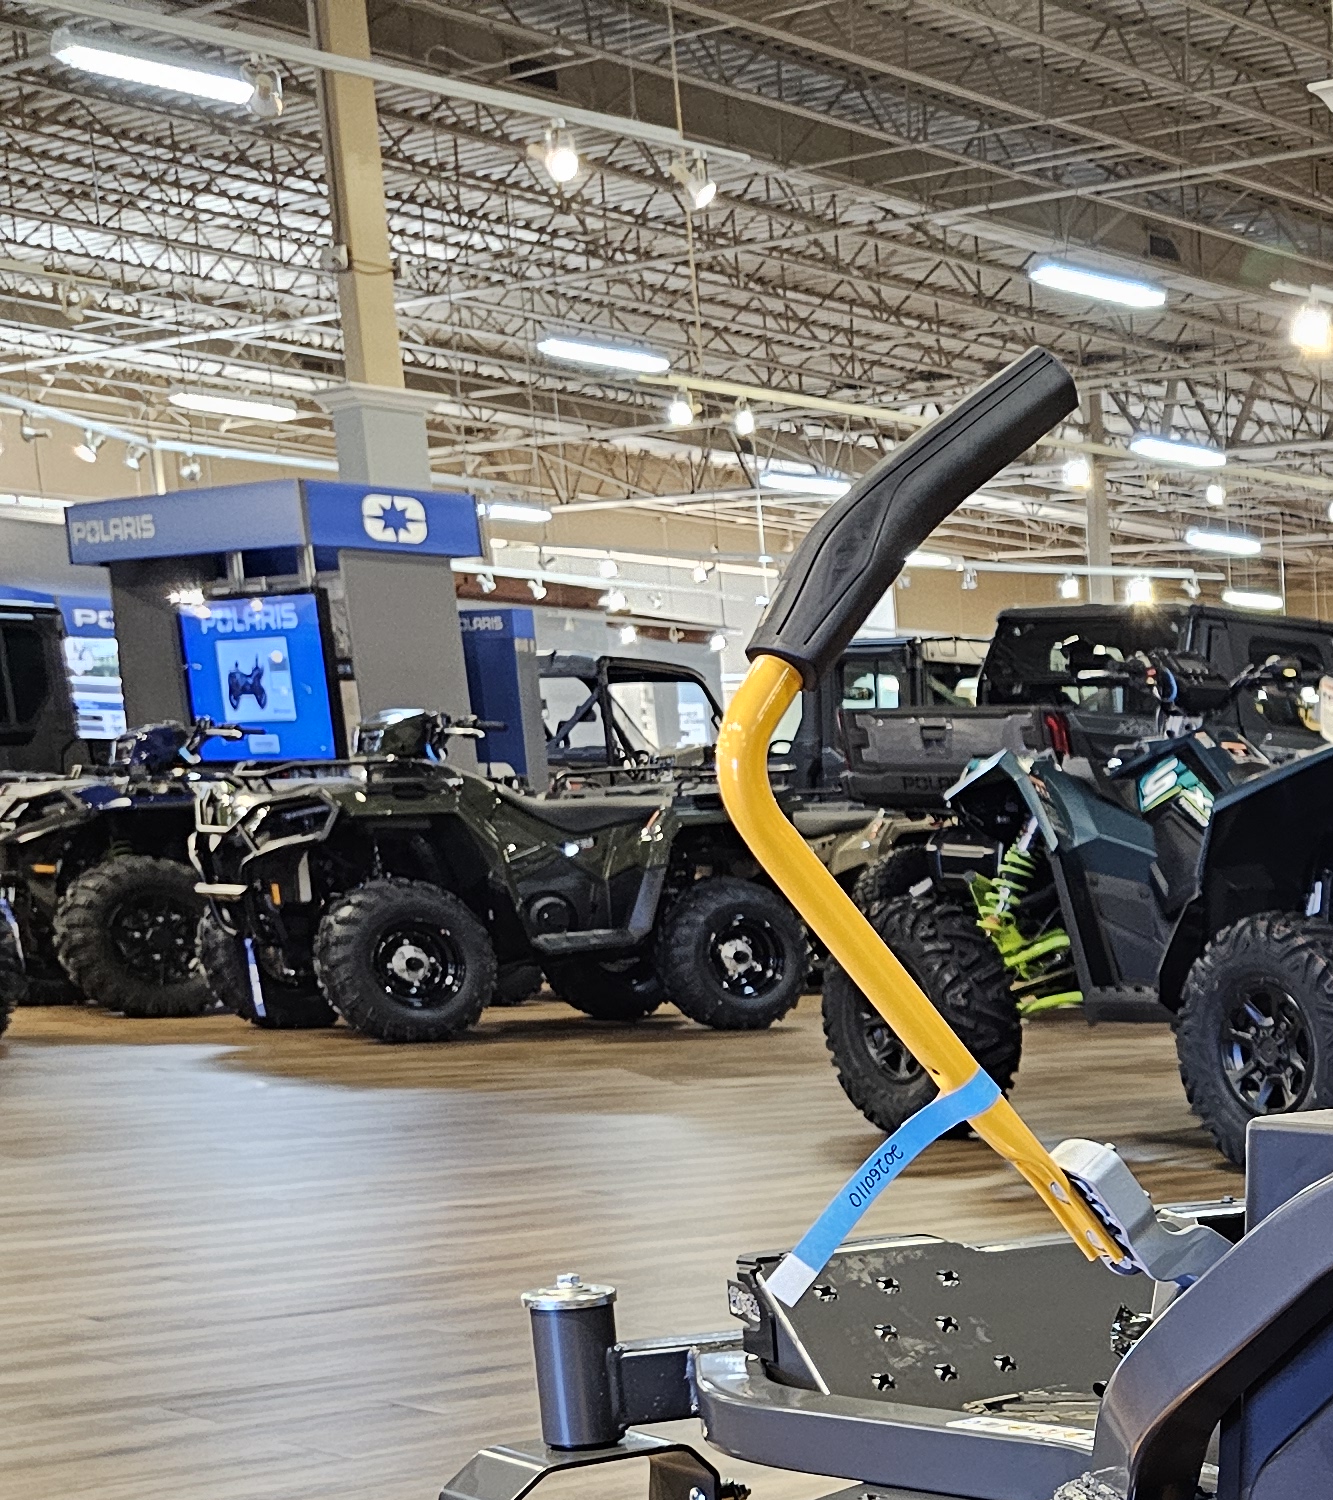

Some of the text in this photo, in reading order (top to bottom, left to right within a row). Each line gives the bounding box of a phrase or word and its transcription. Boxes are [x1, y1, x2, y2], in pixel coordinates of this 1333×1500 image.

[71, 513, 155, 545] POLARIS
[201, 602, 299, 634] POLARIS
[460, 615, 503, 632] OLARIS
